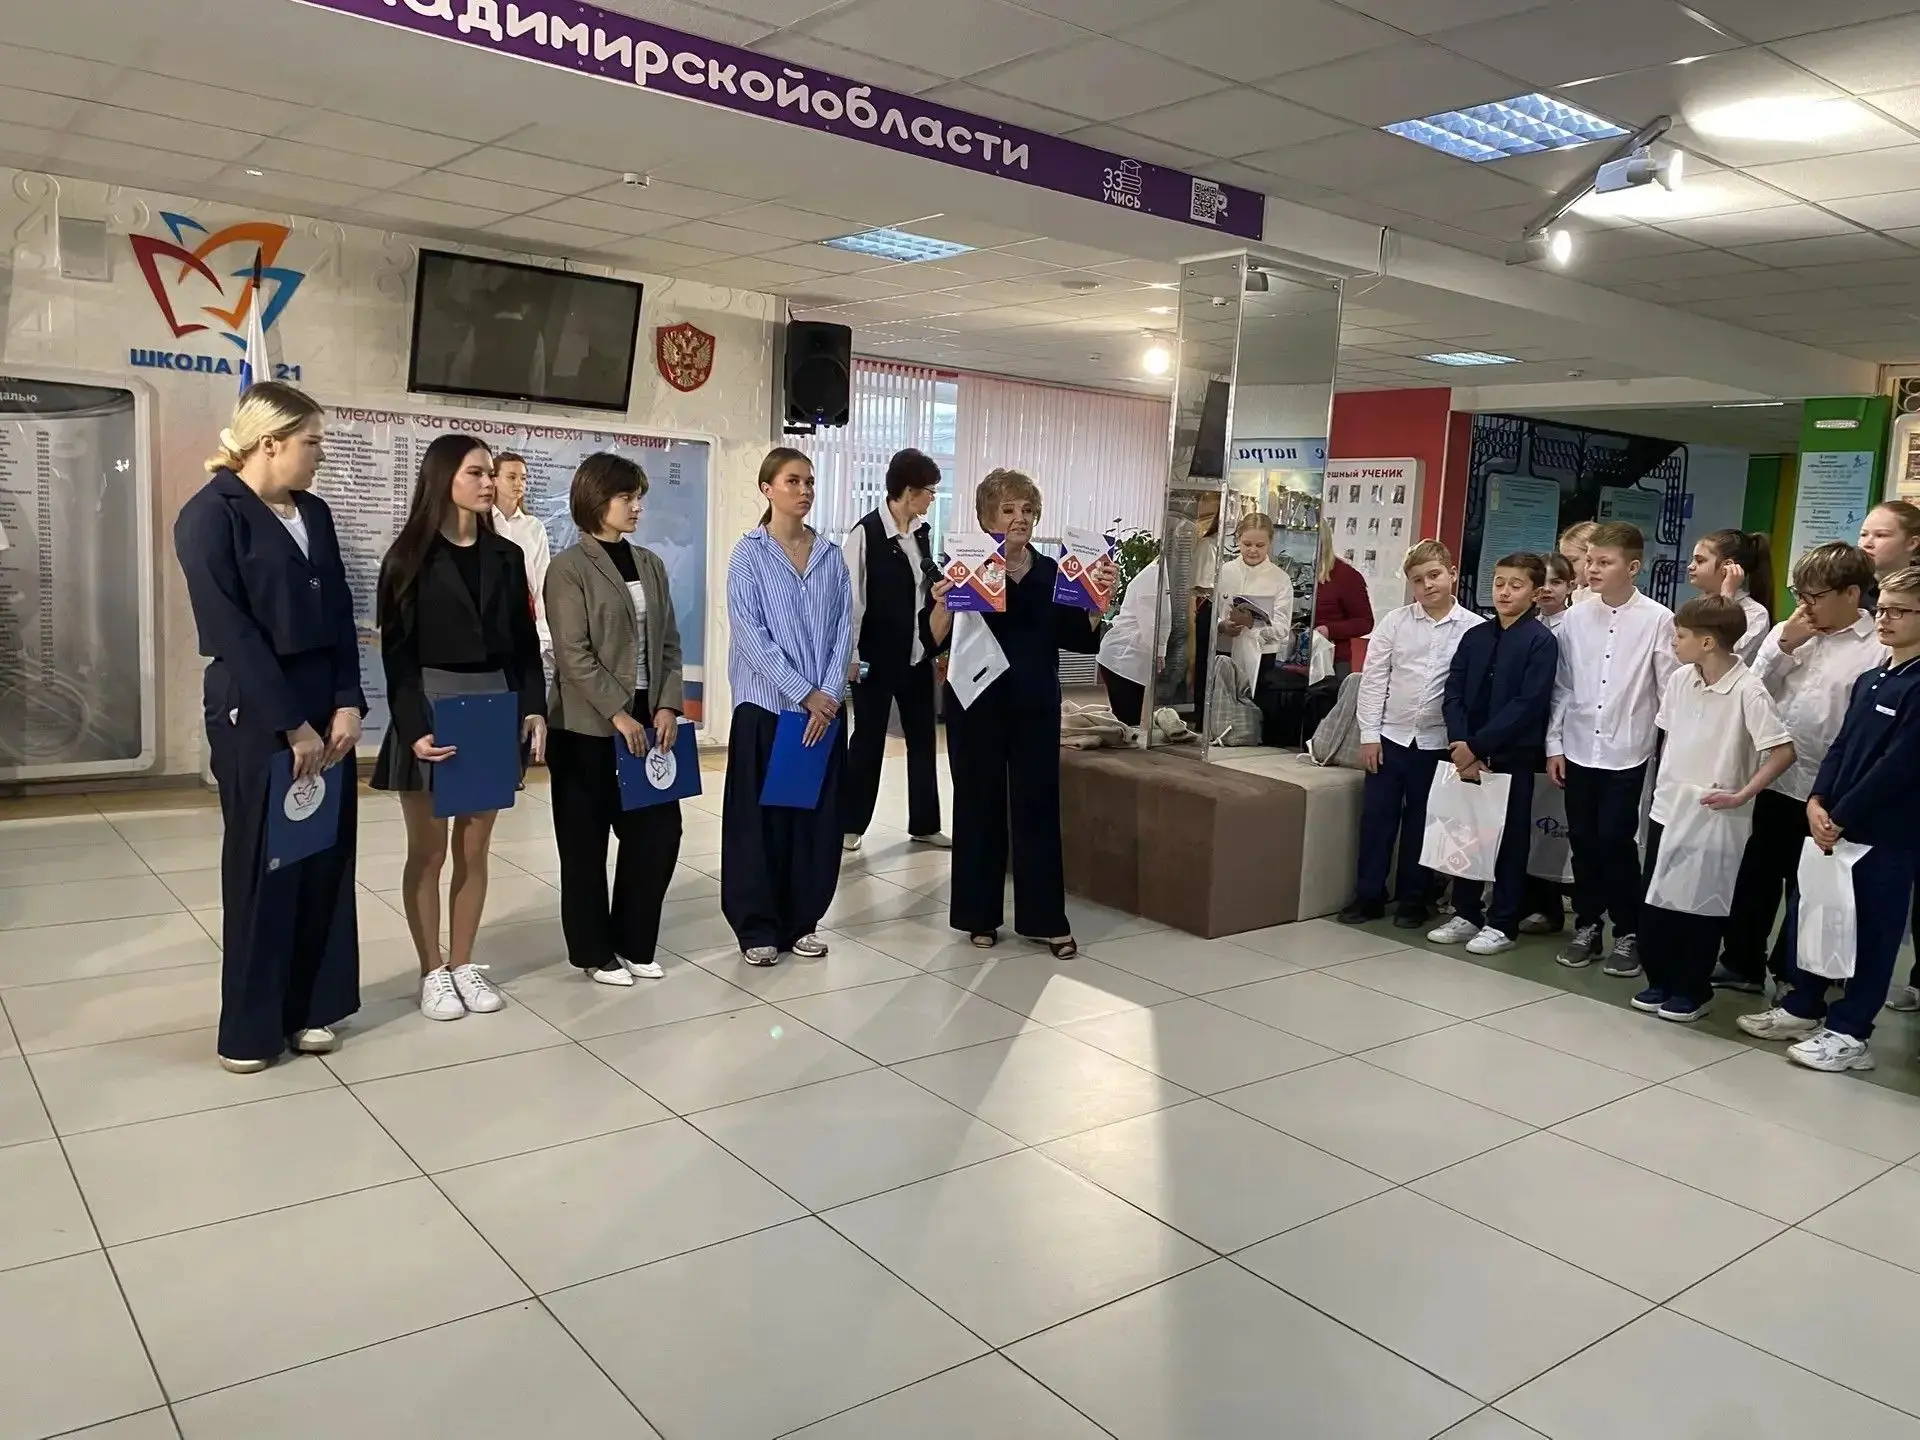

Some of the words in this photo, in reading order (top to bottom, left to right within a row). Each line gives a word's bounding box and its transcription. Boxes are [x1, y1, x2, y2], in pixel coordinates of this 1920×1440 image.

[383, 0, 1029, 170] адимирскойобласти
[1103, 168, 1123, 191] 33
[1103, 188, 1141, 209] УЧИСЬ
[130, 349, 232, 374] ШКОЛА
[276, 363, 301, 381] 21
[336, 407, 405, 425] Медаль
[411, 414, 443, 429] «За
[449, 419, 516, 435] особые
[525, 425, 583, 441] успехи
[594, 433, 602, 443] в
[613, 434, 674, 449] учении»
[1361, 469, 1404, 478] УЧЕНИК
[952, 566, 966, 576] 10
[1067, 560, 1079, 570] 10
